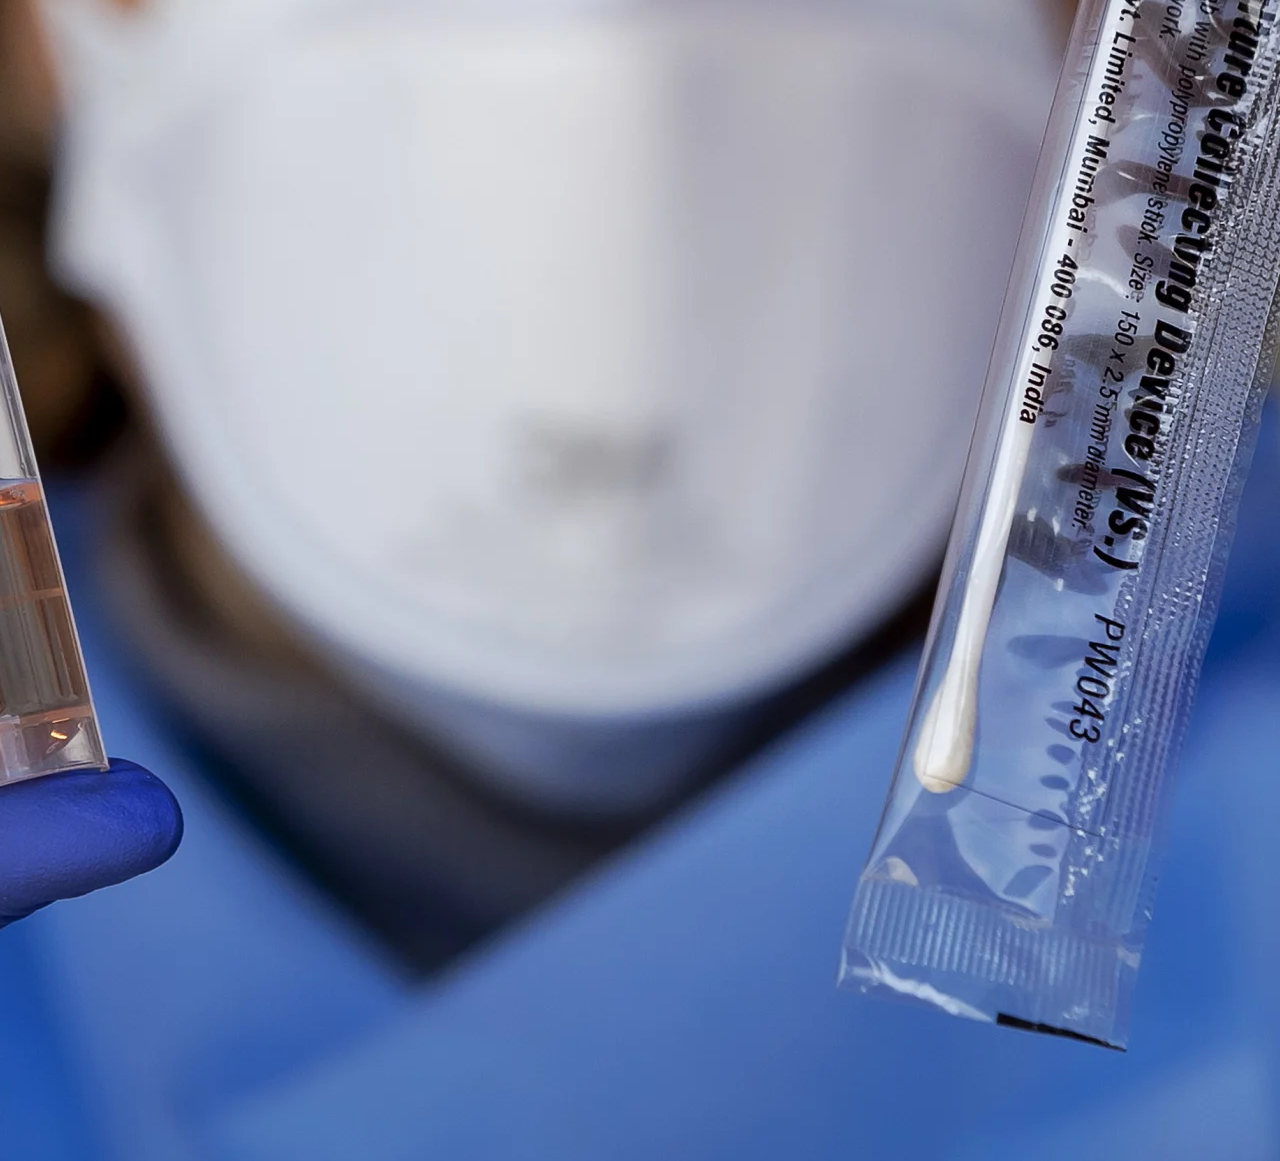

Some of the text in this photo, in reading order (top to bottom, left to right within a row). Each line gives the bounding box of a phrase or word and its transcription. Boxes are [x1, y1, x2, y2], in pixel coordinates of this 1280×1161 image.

[1185, 21, 1214, 62] with
[1088, 31, 1136, 130] Limited,
[1150, 63, 1197, 193] polypropylene
[1066, 135, 1111, 234] Mumbai
[1155, 108, 1247, 314] Collecting
[1136, 197, 1166, 248] stick.
[1050, 254, 1079, 299] 400
[1031, 304, 1067, 356] 086,
[1109, 348, 1126, 363] x
[1114, 310, 1141, 347] 150
[1019, 362, 1053, 424] India
[1099, 365, 1125, 402] 2.5
[1124, 319, 1193, 465] Device
[1089, 403, 1113, 444] mm
[1071, 445, 1108, 532] diameter.
[1093, 468, 1159, 570] (VS.)
[1069, 613, 1126, 744] PW043
